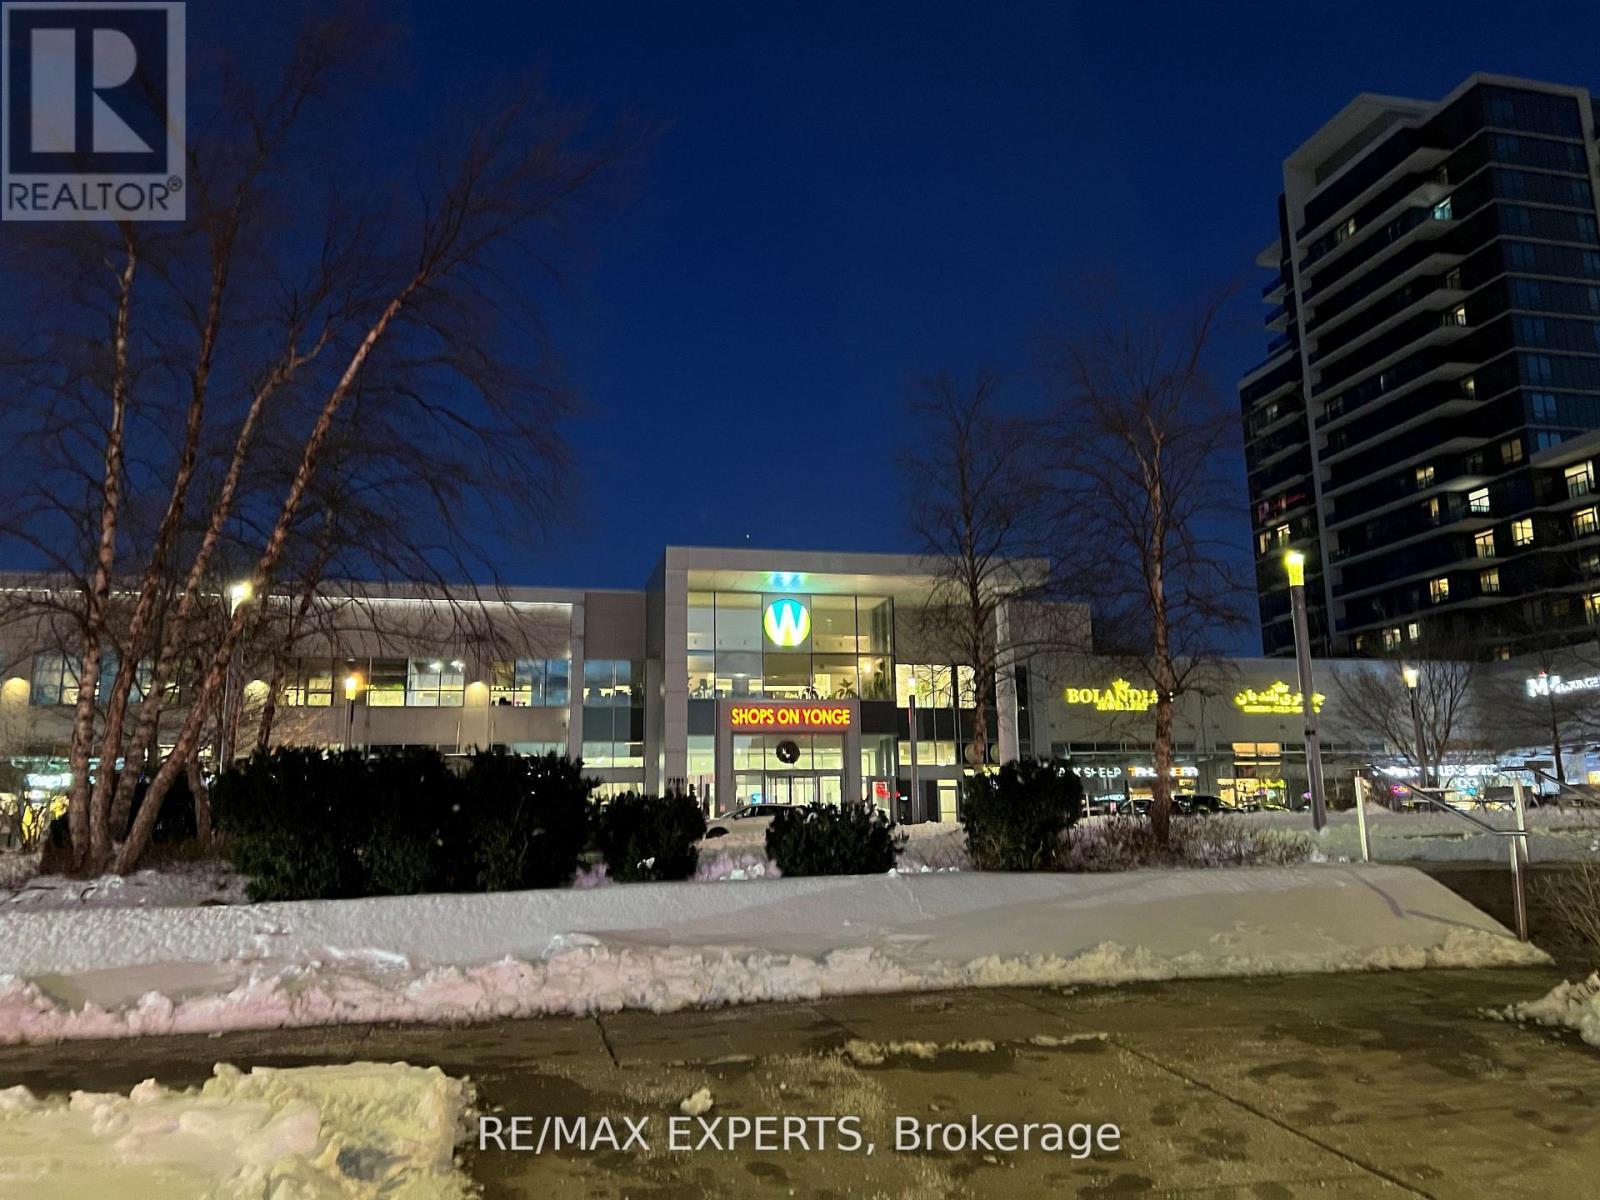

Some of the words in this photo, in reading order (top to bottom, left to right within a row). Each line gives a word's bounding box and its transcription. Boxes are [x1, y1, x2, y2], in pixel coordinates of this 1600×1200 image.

[766, 602, 809, 646] W
[1066, 688, 1172, 704] BOLANDIA
[731, 708, 774, 725] SHOPS
[777, 708, 800, 725] ON
[802, 708, 851, 725] YONGE
